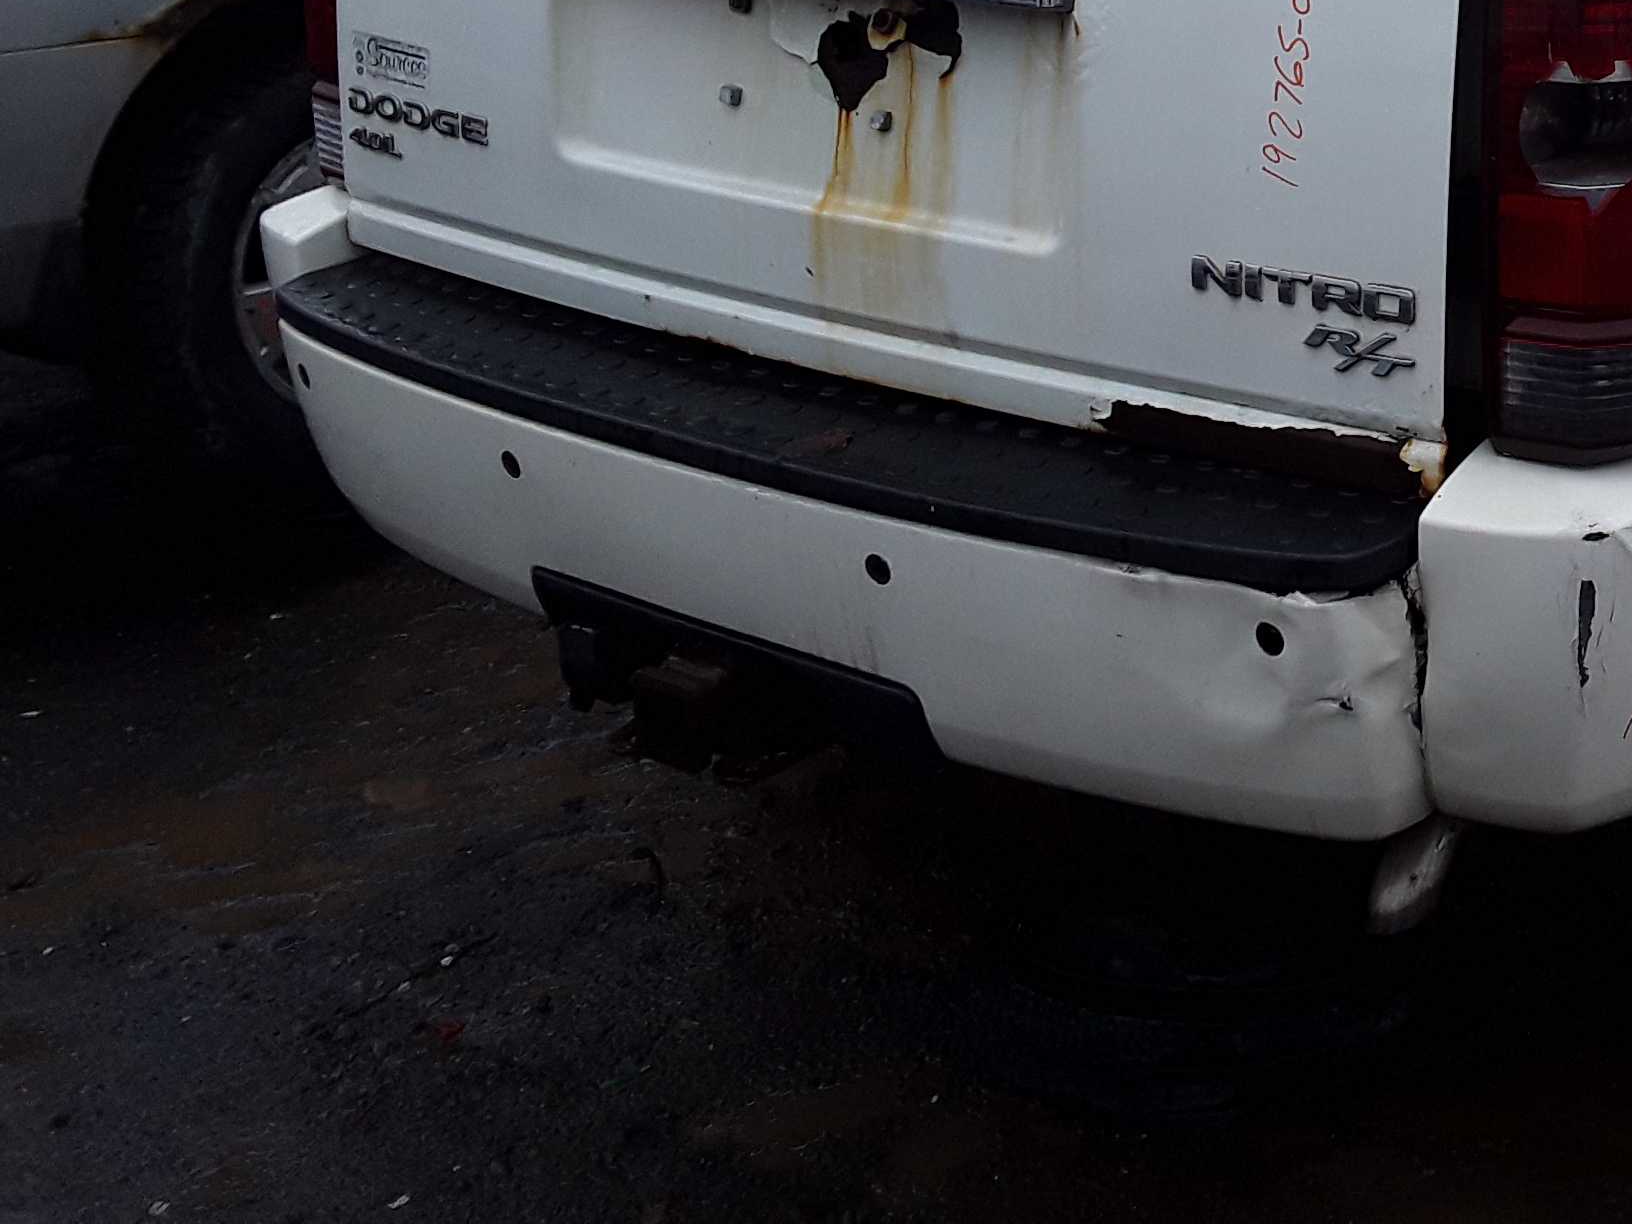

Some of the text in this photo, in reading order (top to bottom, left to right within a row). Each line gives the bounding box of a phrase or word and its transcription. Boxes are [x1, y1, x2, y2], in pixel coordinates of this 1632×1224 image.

[348, 88, 489, 147] DODGE
[1191, 254, 1416, 325] NITRO
[1303, 323, 1416, 377] R/T
